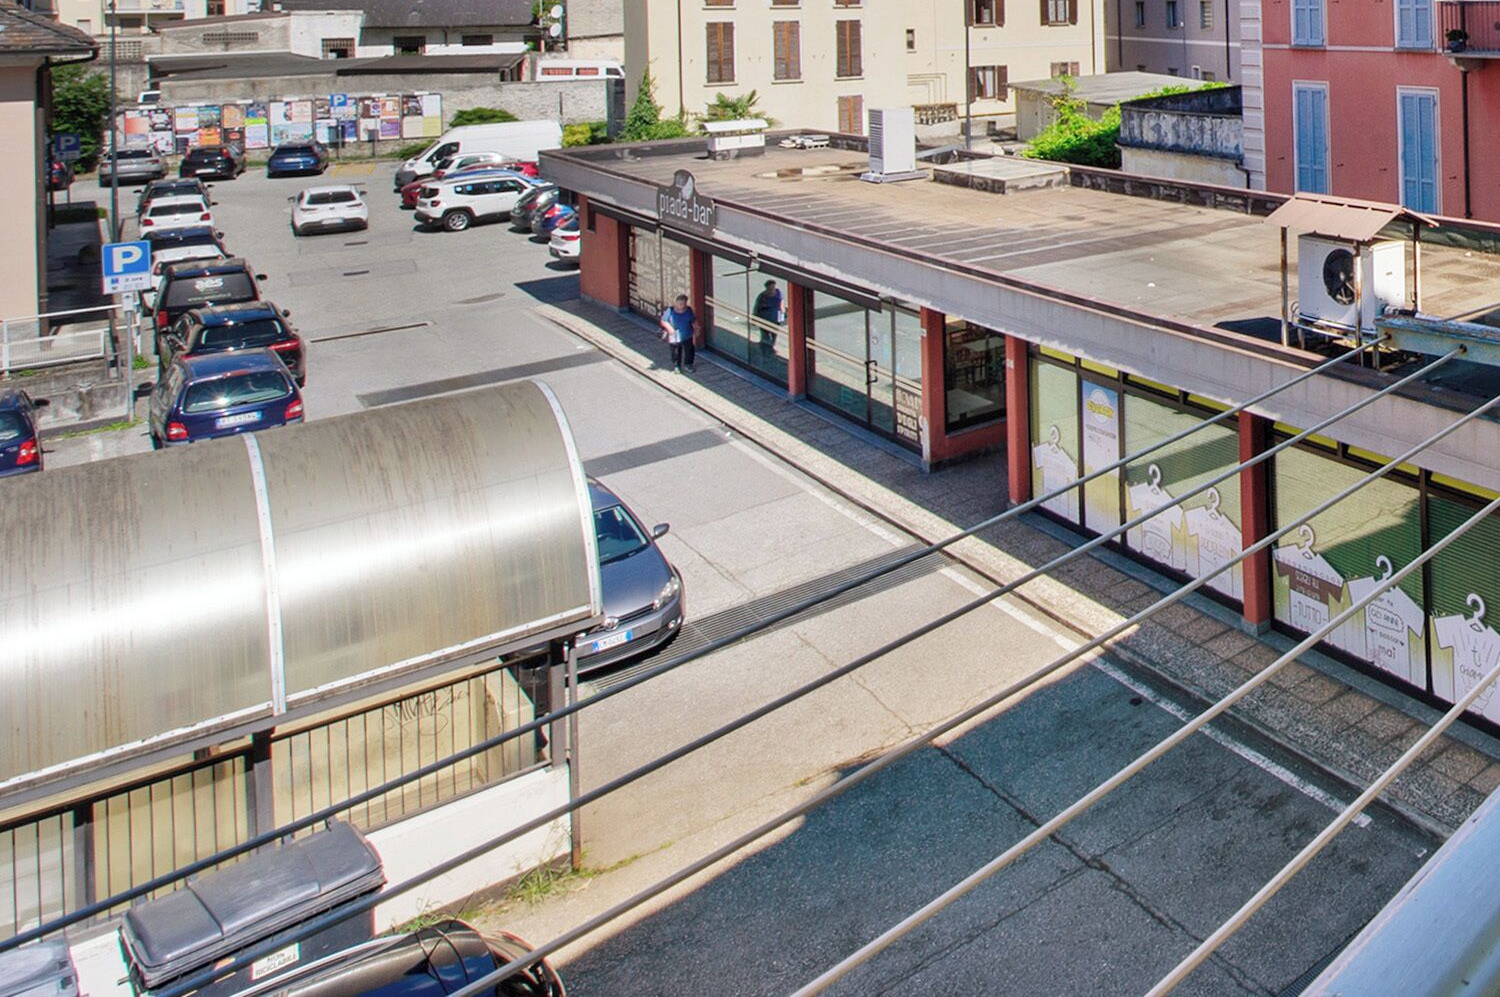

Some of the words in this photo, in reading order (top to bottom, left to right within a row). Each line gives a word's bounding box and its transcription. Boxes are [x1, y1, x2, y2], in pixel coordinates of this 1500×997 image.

[333, 94, 345, 107] P
[60, 136, 77, 150] P
[659, 192, 712, 225] piada-bar
[112, 245, 143, 273] P
